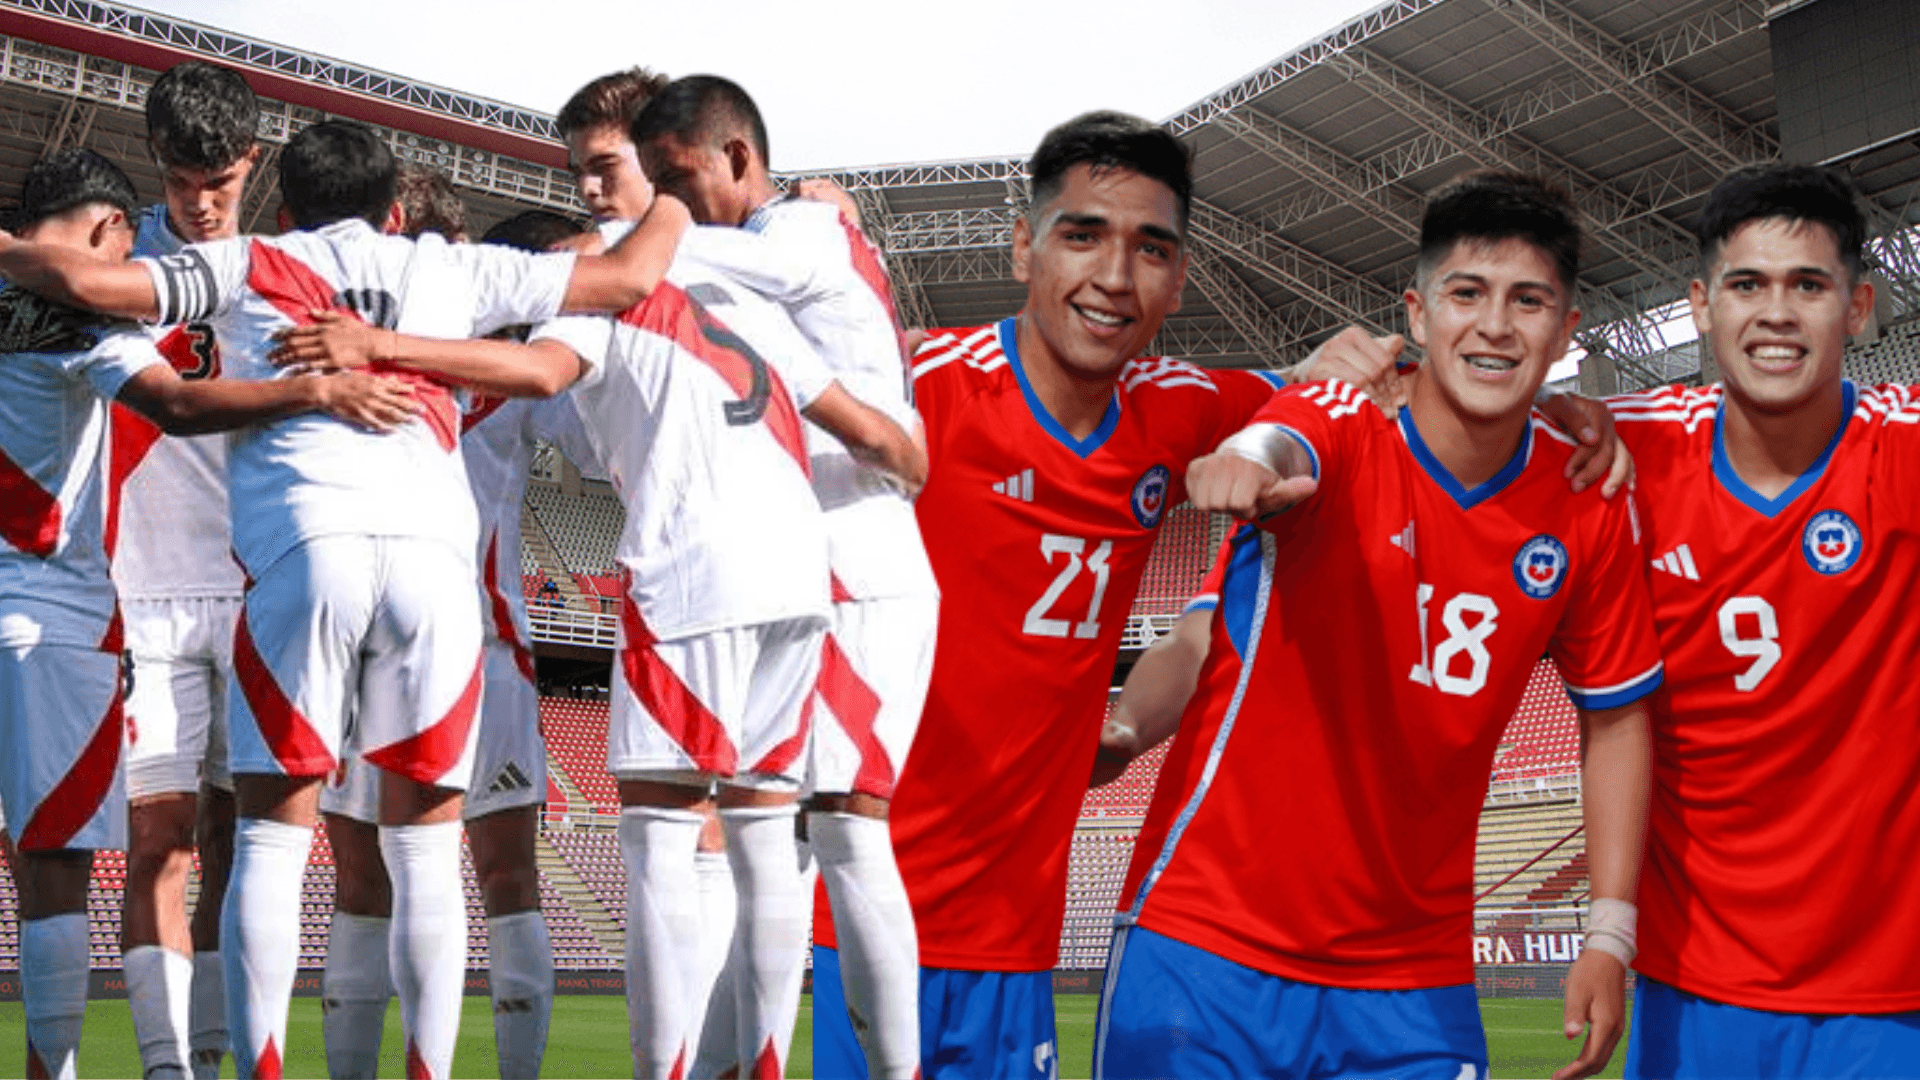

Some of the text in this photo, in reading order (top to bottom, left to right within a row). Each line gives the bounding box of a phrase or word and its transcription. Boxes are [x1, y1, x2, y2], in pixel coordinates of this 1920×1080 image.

[181, 322, 215, 380] 3
[687, 283, 771, 427] 5
[1022, 533, 1113, 640] 21
[1408, 582, 1500, 697] 18
[1717, 595, 1782, 692] 9
